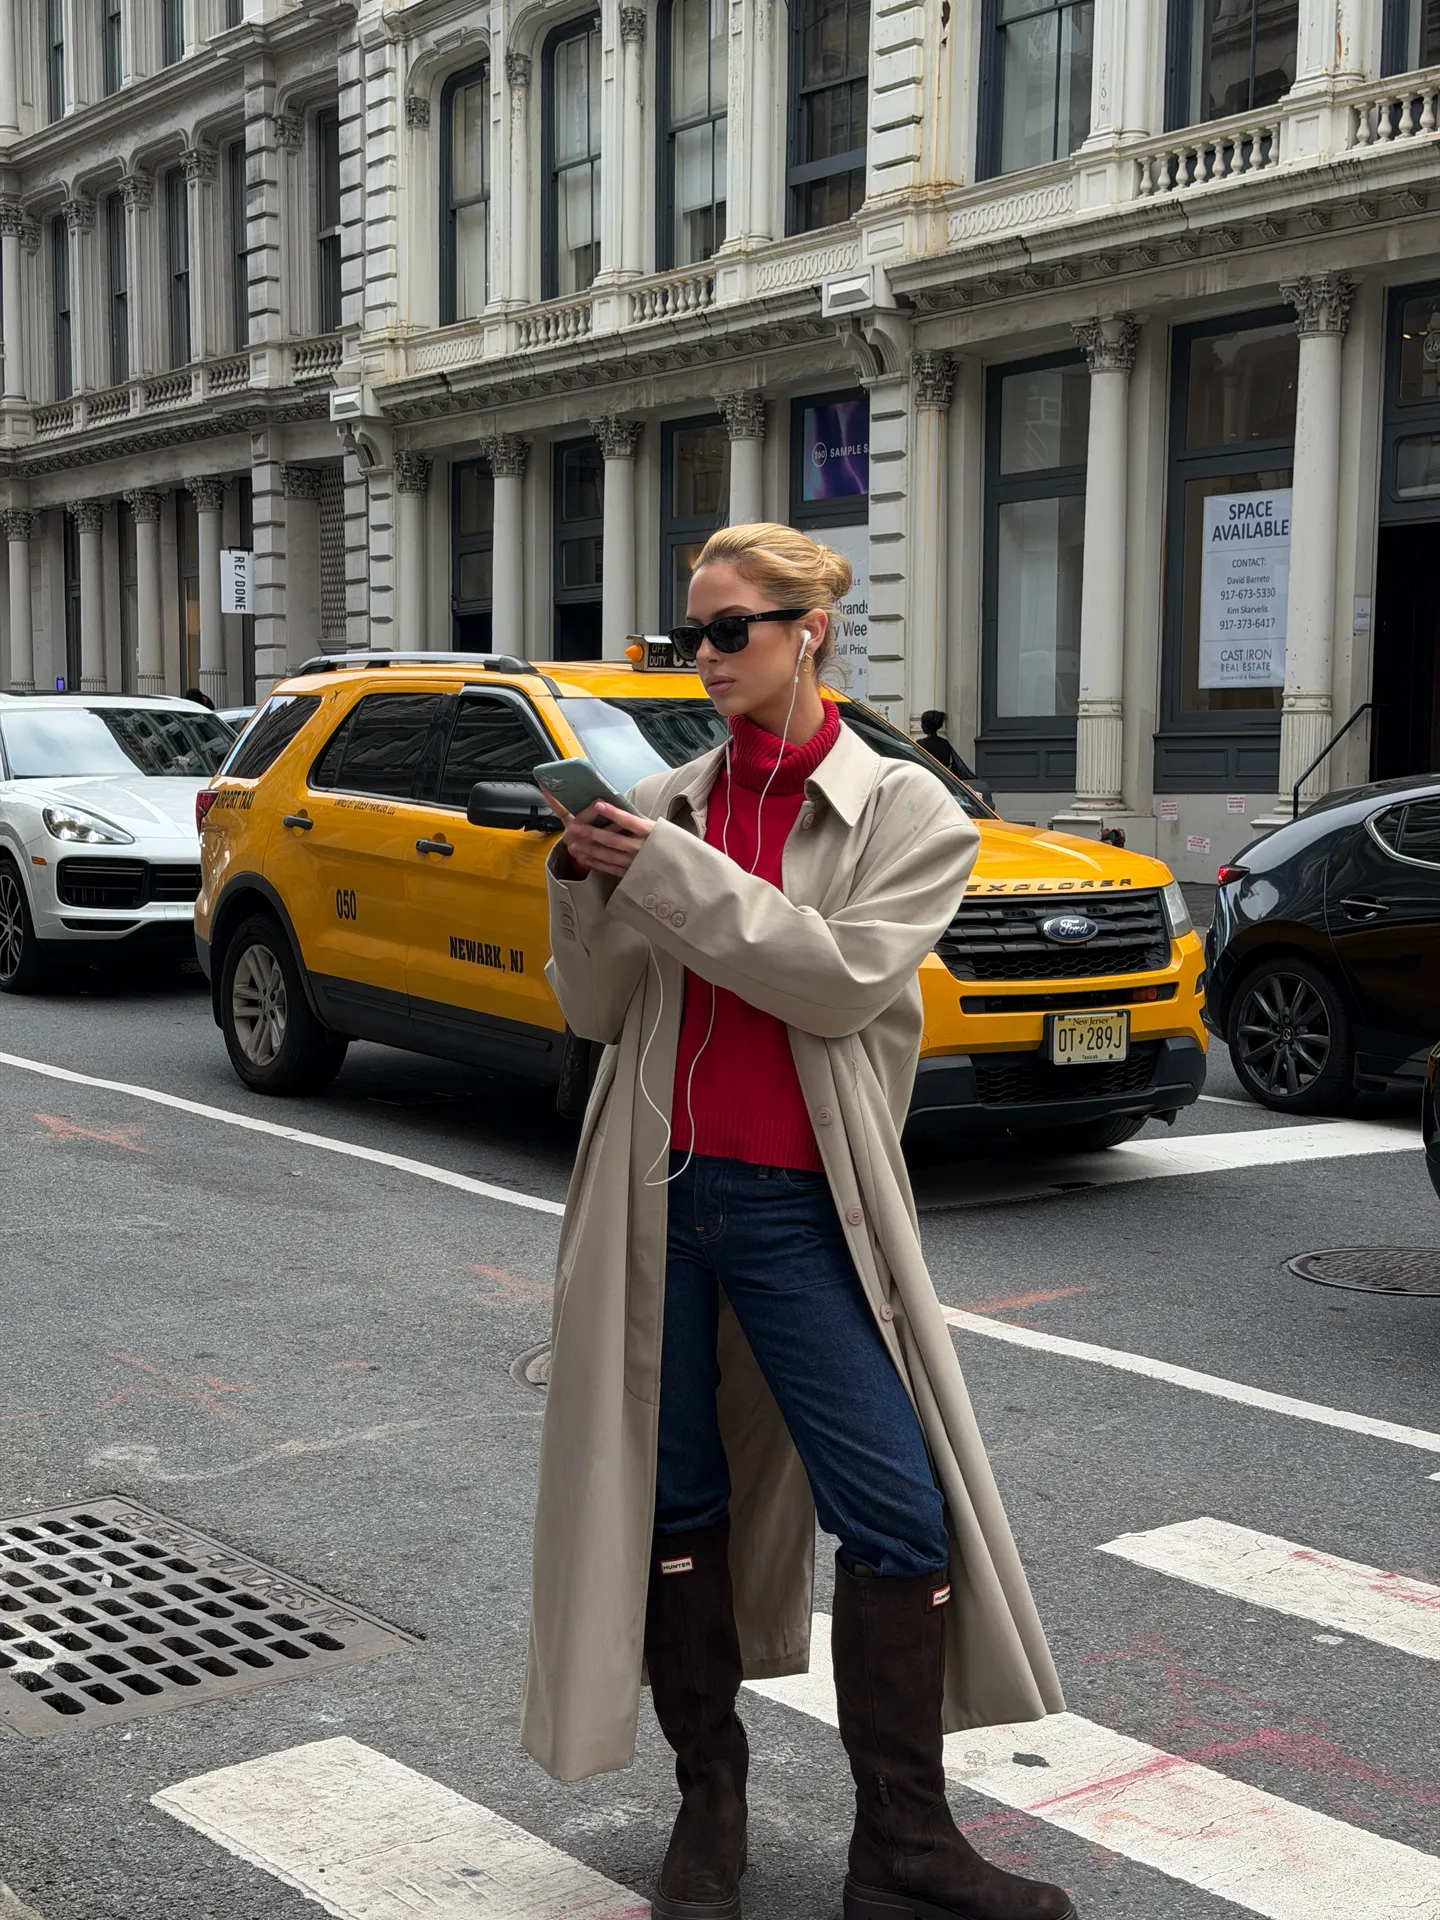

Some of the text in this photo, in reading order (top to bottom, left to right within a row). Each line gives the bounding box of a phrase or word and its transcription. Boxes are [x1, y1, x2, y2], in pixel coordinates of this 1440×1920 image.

[830, 443, 869, 458] SAMPLE S
[1229, 500, 1273, 520] SPACE
[1212, 519, 1289, 542] AVAILABLE
[1232, 557, 1266, 568] CONTACT:
[234, 556, 246, 610] RE/DONE
[1227, 575, 1270, 585] David Barreto
[1220, 587, 1276, 600] 917-673-5330
[1227, 606, 1239, 614] Kim
[843, 621, 867, 637] Wee
[1219, 617, 1276, 630] 917-373-6417
[652, 644, 667, 653] OFF
[1220, 648, 1272, 662] CAST IRON
[649, 656, 667, 666] DUTY
[1220, 661, 1271, 672] REAL ESTATE
[239, 790, 257, 810] TAXI
[965, 878, 1132, 892] EXPLORER
[336, 888, 357, 921] 050
[1059, 918, 1089, 935] Ford
[449, 936, 524, 974] NEWARK, NJ
[1072, 1017, 1109, 1026] New Jersey
[1086, 1025, 1122, 1051] 289J
[663, 1561, 691, 1570] HUNTER
